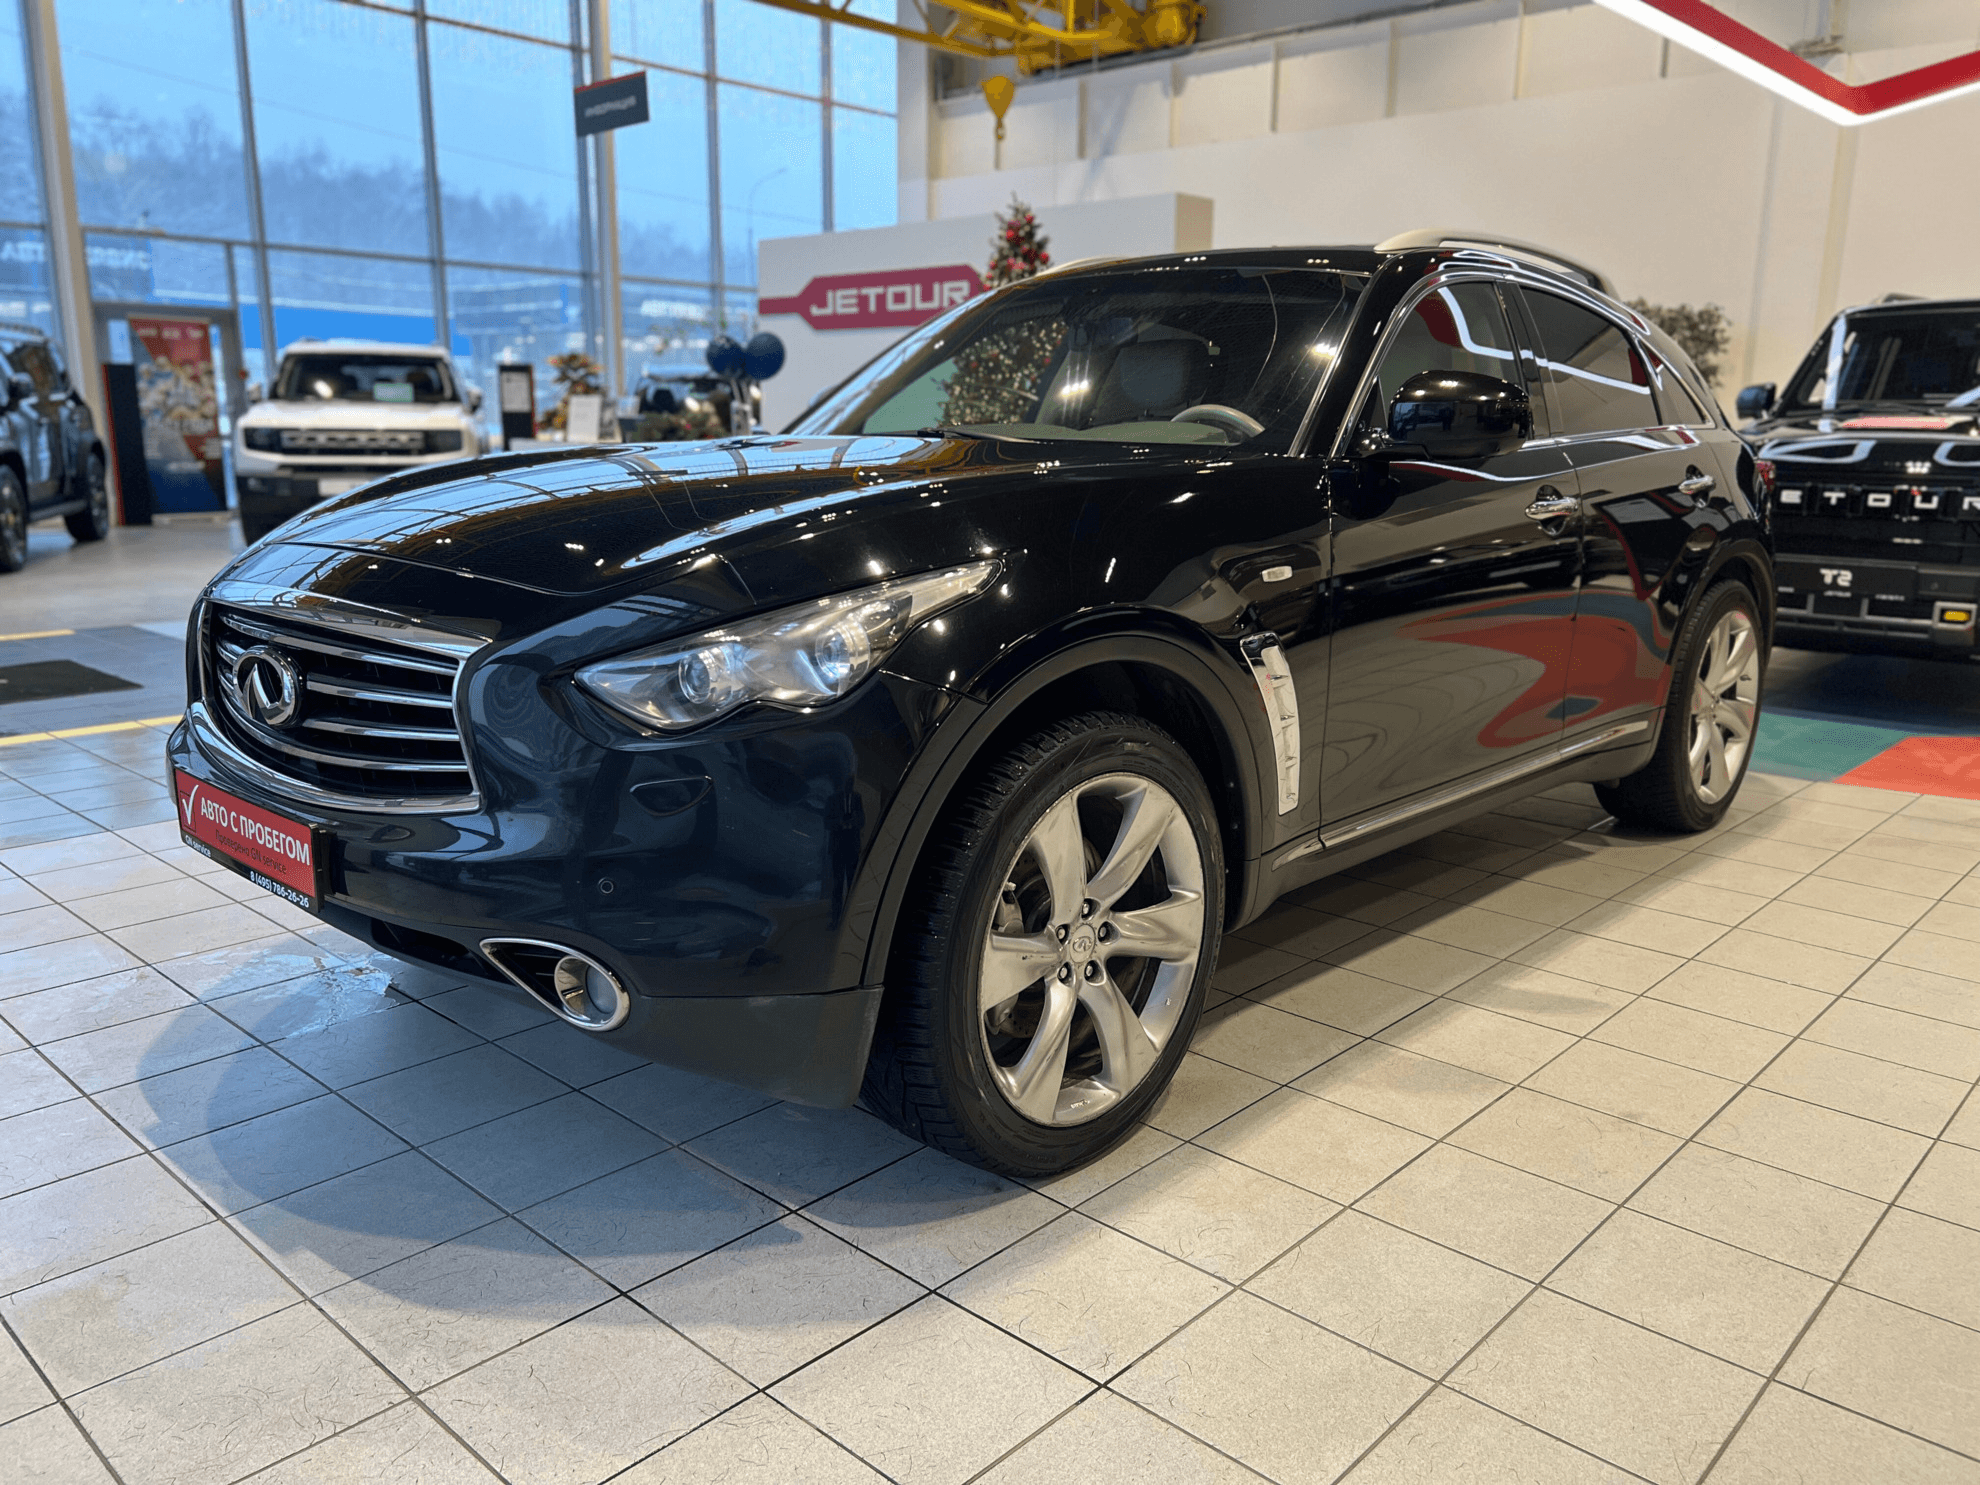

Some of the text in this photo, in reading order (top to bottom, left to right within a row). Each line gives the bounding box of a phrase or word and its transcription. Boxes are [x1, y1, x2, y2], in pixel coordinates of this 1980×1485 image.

[810, 280, 970, 316] JETOUR
[1780, 489, 1980, 511] ETOUR
[1820, 568, 1853, 587] T2
[201, 797, 310, 866] АВТО С ПРОБЕГОМ
[250, 871, 310, 908] 8 (495) 786-26-26
